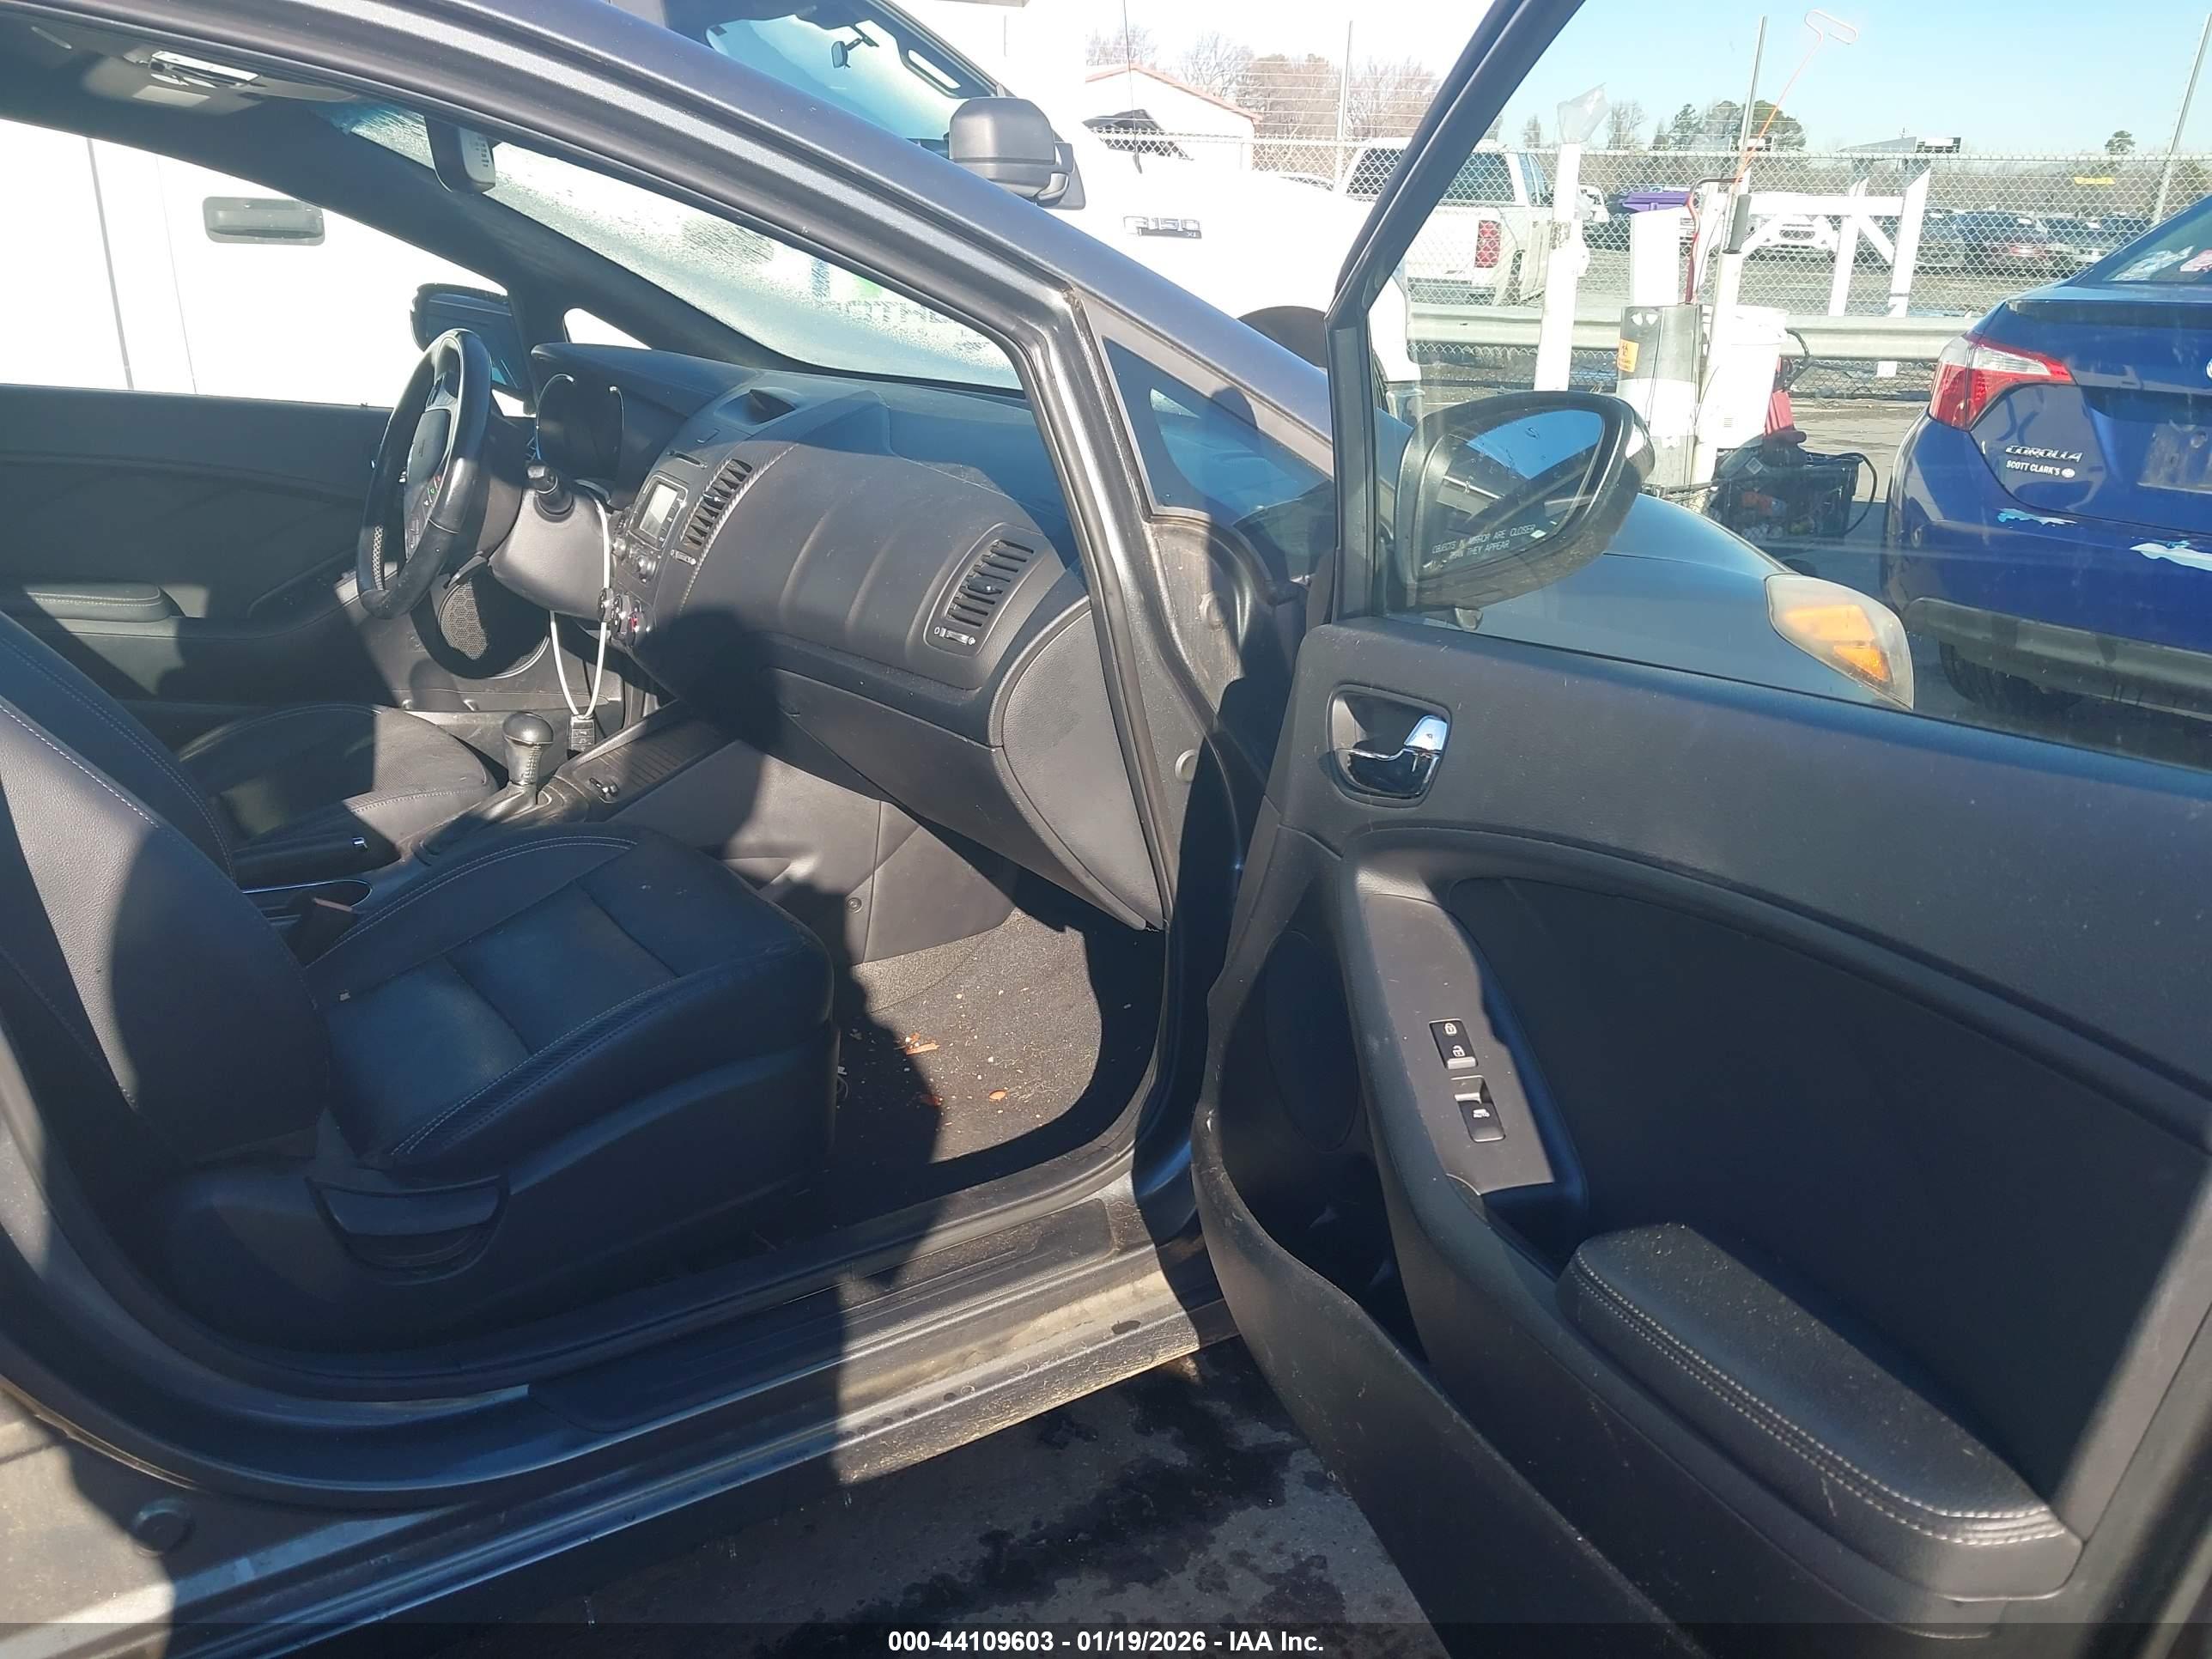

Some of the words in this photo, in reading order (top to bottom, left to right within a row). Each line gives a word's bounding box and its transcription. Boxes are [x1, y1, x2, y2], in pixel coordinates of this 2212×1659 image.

[2006, 446, 2082, 462] COROLLA
[2006, 460, 2030, 471] SCOTT
[2030, 464, 2060, 476] CLARK'S
[1494, 530, 1506, 539] ARE
[1510, 525, 1535, 537] CLOSER
[1484, 540, 1510, 551] APPEAR
